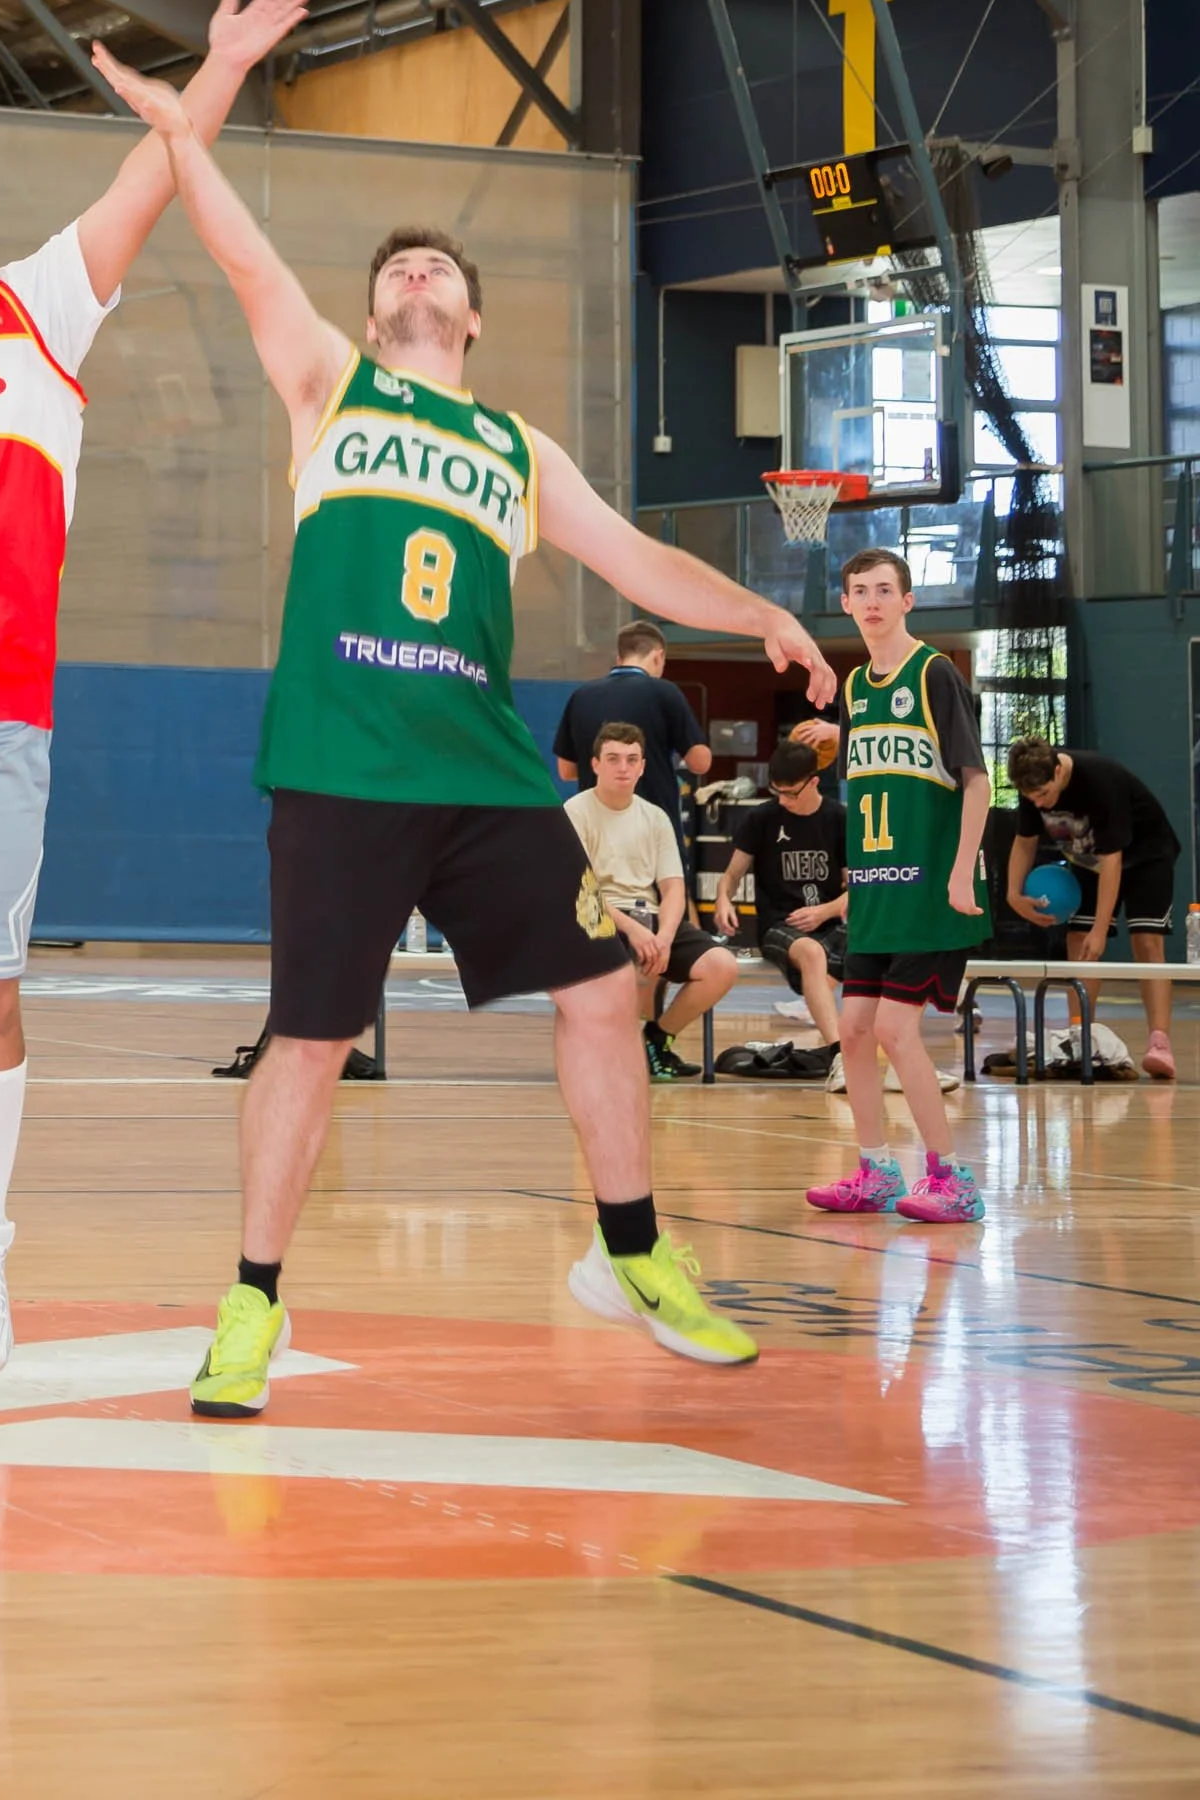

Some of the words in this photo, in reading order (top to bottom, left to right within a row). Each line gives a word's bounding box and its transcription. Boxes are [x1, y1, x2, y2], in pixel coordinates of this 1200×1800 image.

[334, 431, 519, 527] GATOR
[401, 527, 457, 623] 8
[860, 792, 893, 852] 11
[781, 850, 829, 881] NETS
